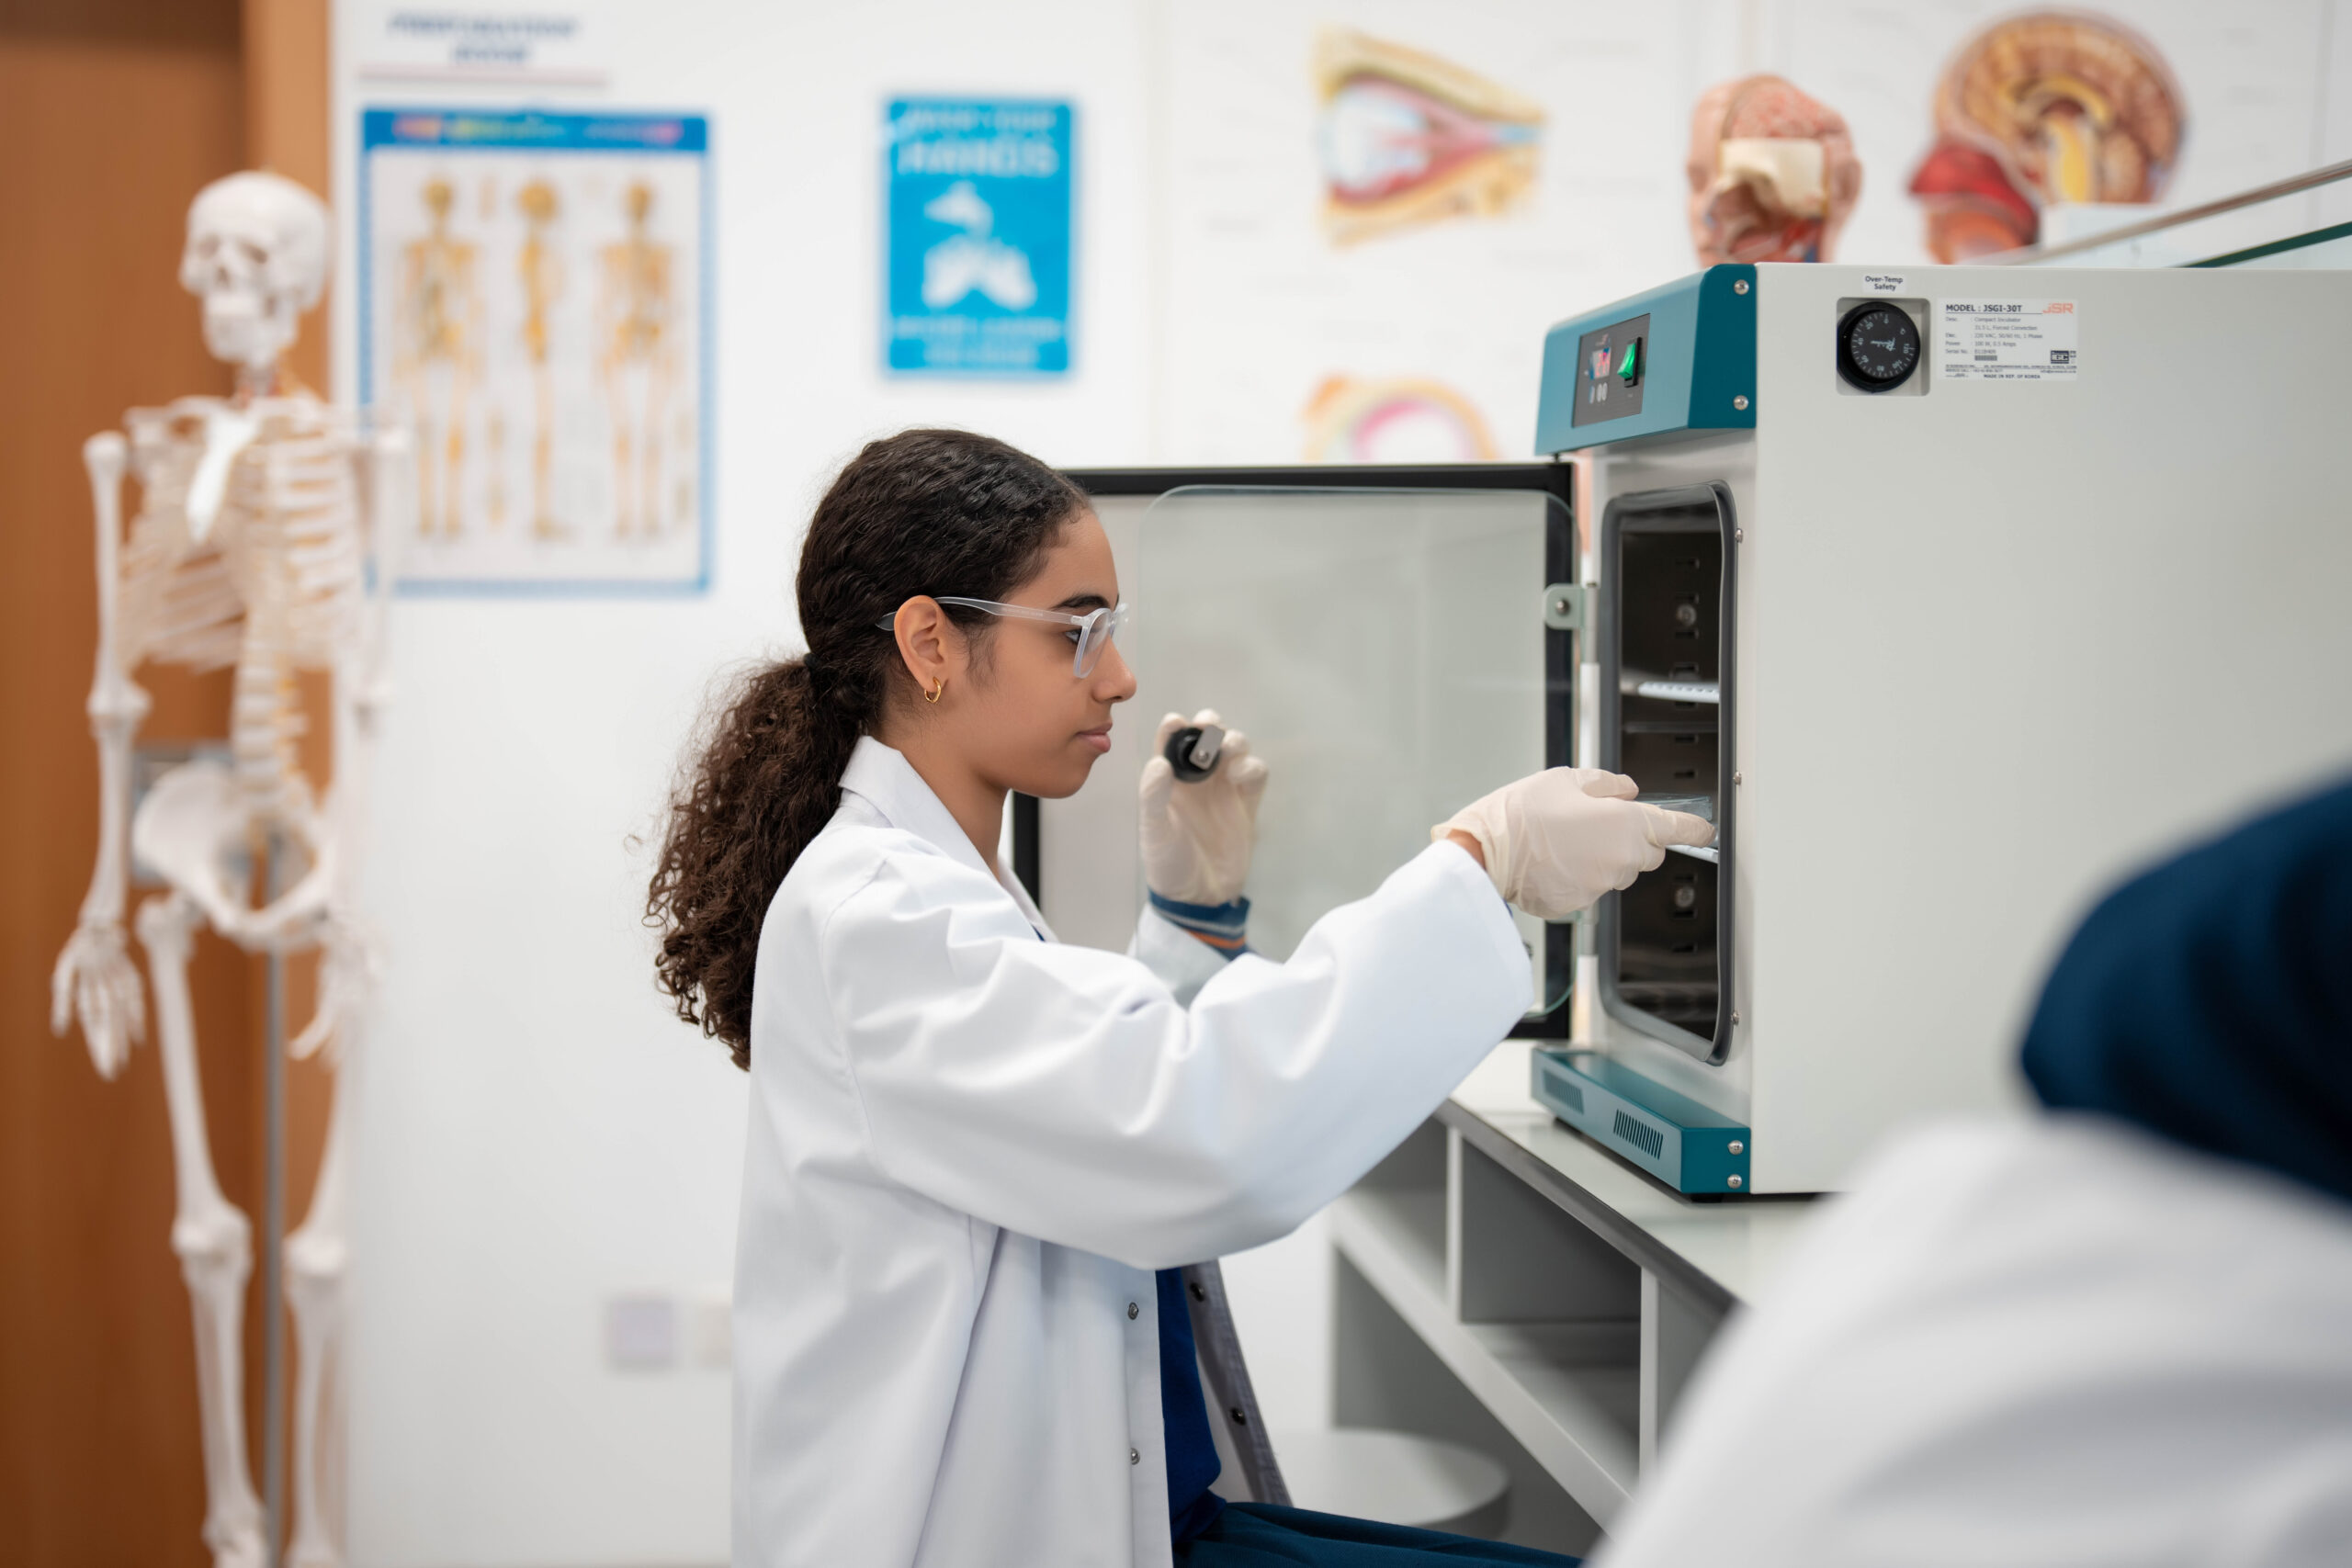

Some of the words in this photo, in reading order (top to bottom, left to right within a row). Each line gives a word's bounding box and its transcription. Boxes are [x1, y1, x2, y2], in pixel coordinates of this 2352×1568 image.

[1865, 276, 1903, 284] Over-Temp
[1946, 304, 1975, 312] MODEL
[1983, 304, 2022, 312] JSGI-30T
